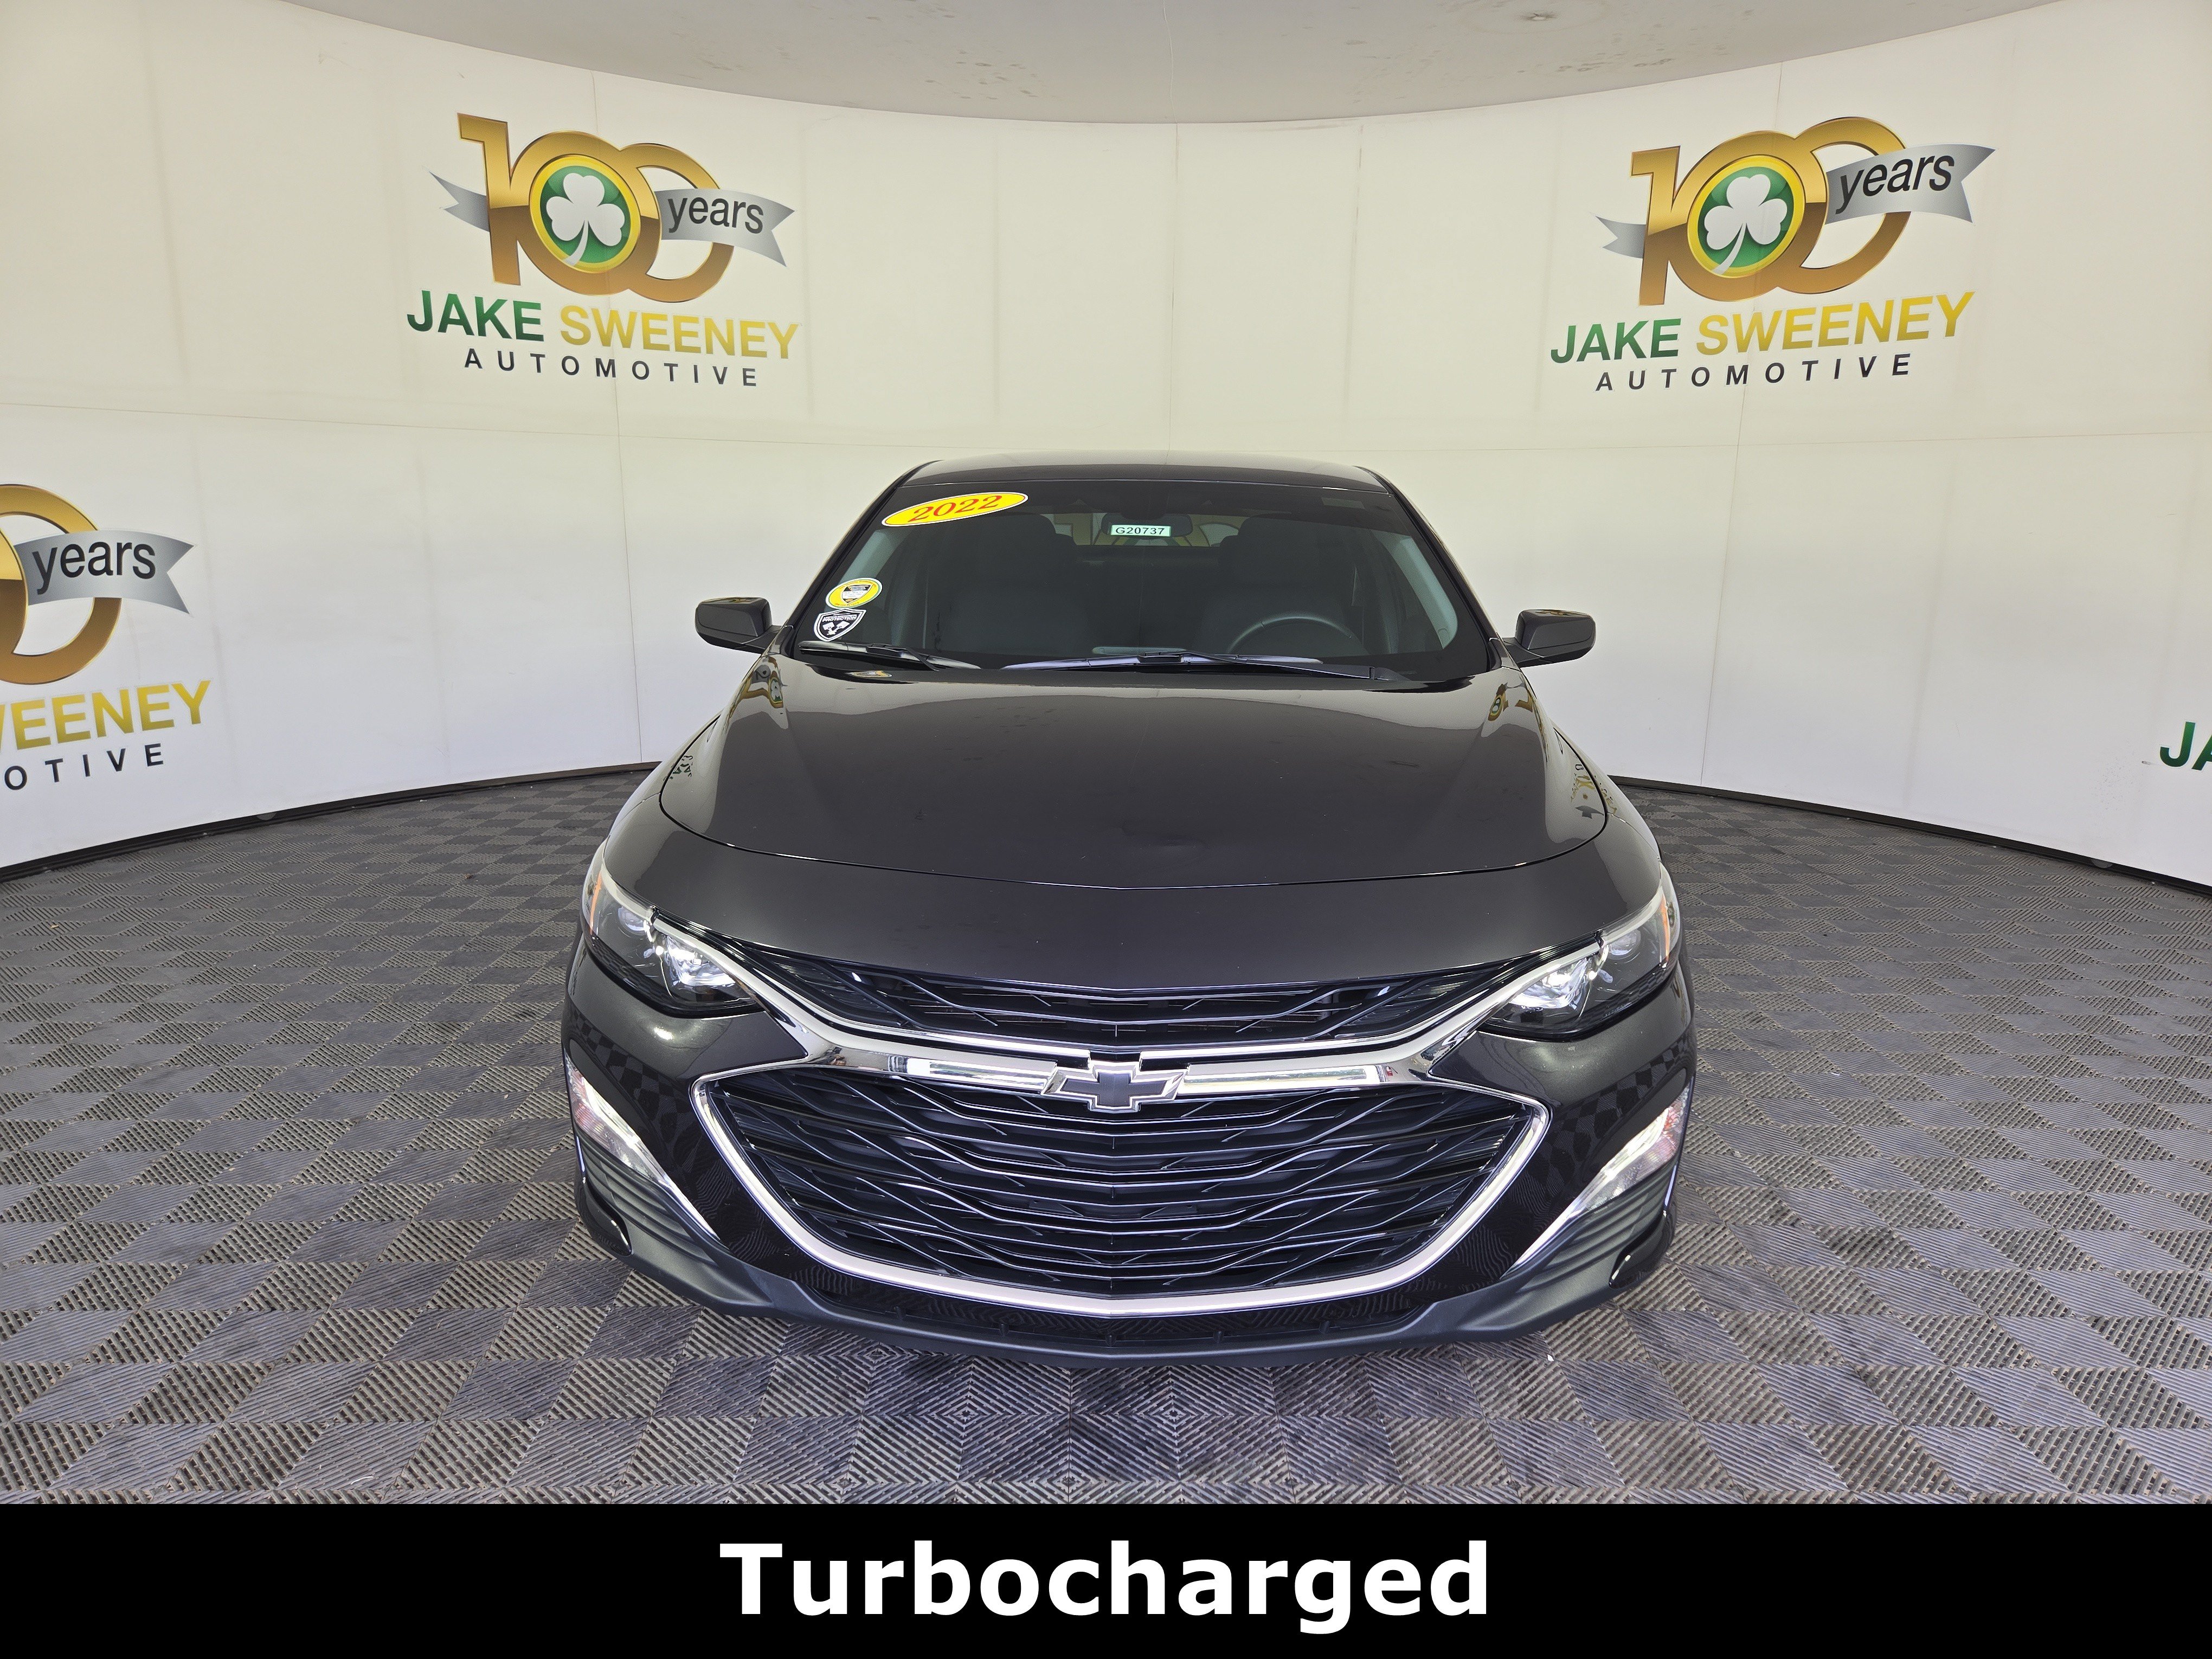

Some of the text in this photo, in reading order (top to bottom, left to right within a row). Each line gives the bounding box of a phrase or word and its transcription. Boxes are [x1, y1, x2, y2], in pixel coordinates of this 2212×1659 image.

[1835, 155, 1954, 215] years
[667, 196, 764, 234] years
[407, 290, 802, 359] JAKE SWEENEY
[1551, 291, 1975, 364] JAKE SWEENEY
[464, 348, 757, 387] AUTOMOTIVE
[1596, 353, 1911, 391] AUTOMOTIVE
[907, 495, 1002, 523] 2022
[1115, 527, 1165, 535] G20737
[32, 541, 156, 596] years
[0, 680, 211, 753] EENEY
